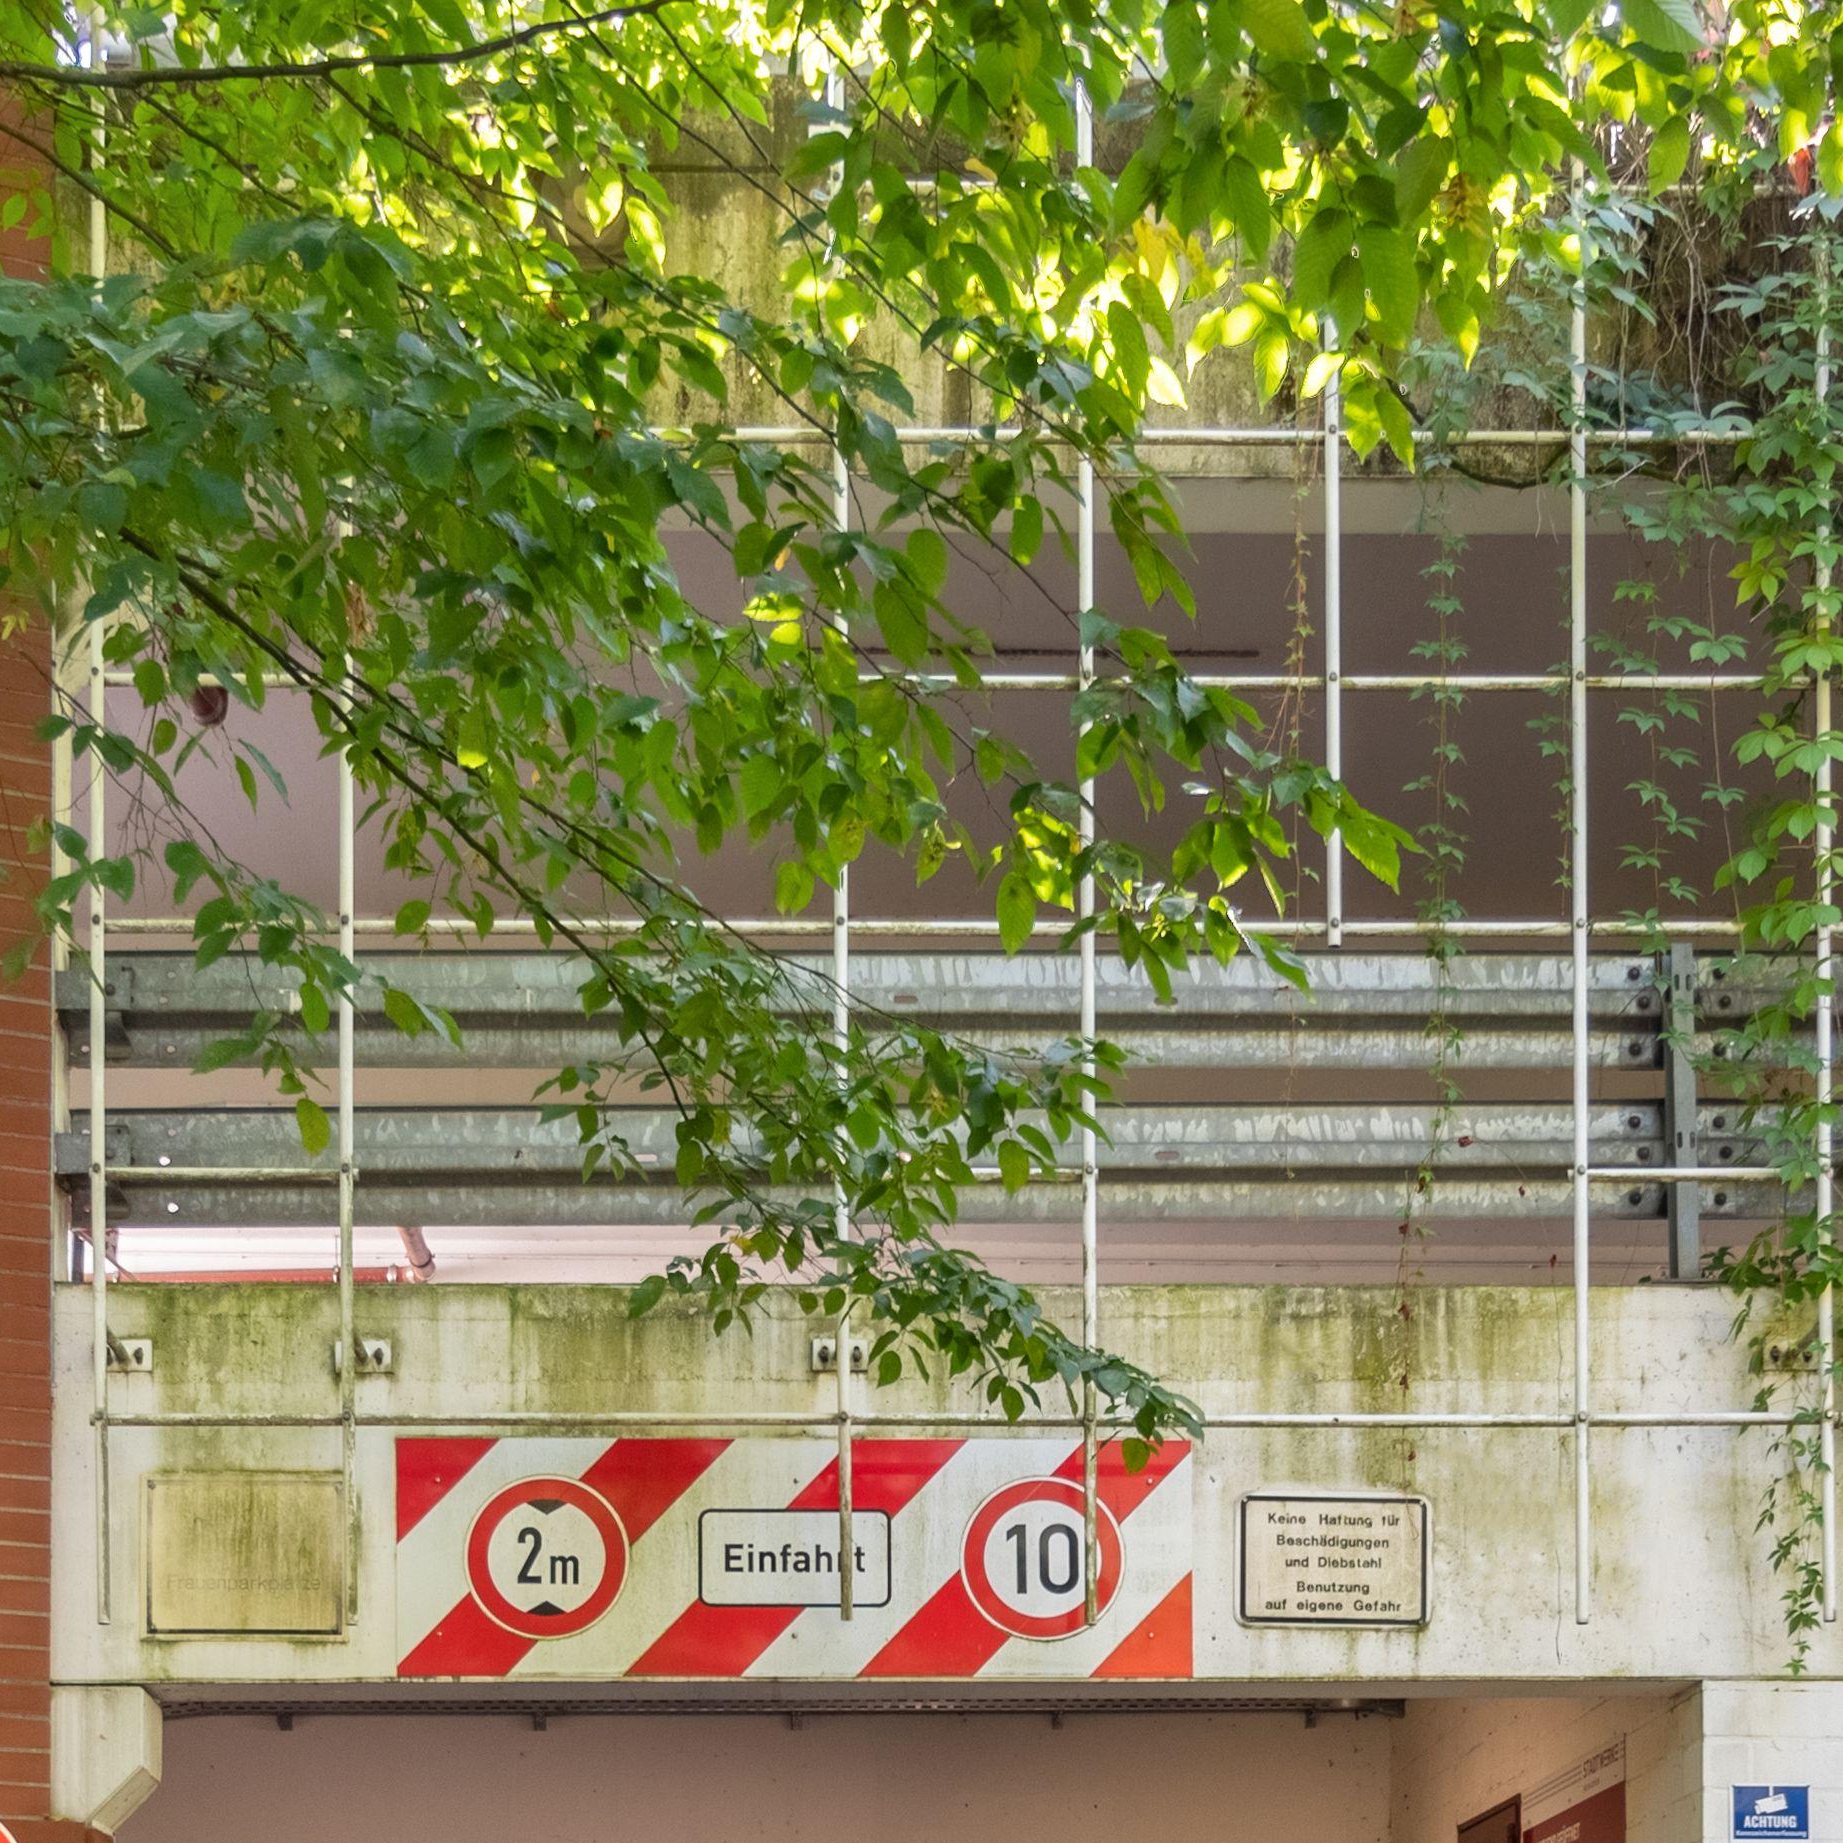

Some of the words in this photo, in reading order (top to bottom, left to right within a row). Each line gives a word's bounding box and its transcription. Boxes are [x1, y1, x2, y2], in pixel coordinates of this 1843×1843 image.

[1268, 1513, 1306, 1524] Keine
[1319, 1514, 1372, 1527] Haftung
[1382, 1515, 1399, 1526] für
[1277, 1535, 1389, 1549] Beschädigungen
[517, 1527, 542, 1584] 2
[550, 1555, 579, 1584] m
[1006, 1524, 1079, 1594] 10
[1285, 1558, 1308, 1567] und
[1318, 1557, 1381, 1568] Diebstahl
[1297, 1581, 1369, 1594] Benutzung
[1265, 1599, 1286, 1610] auf
[1297, 1600, 1343, 1612] eigene
[1354, 1601, 1401, 1611] Gefahr
[1744, 1816, 1797, 1828] ACHTUNG
